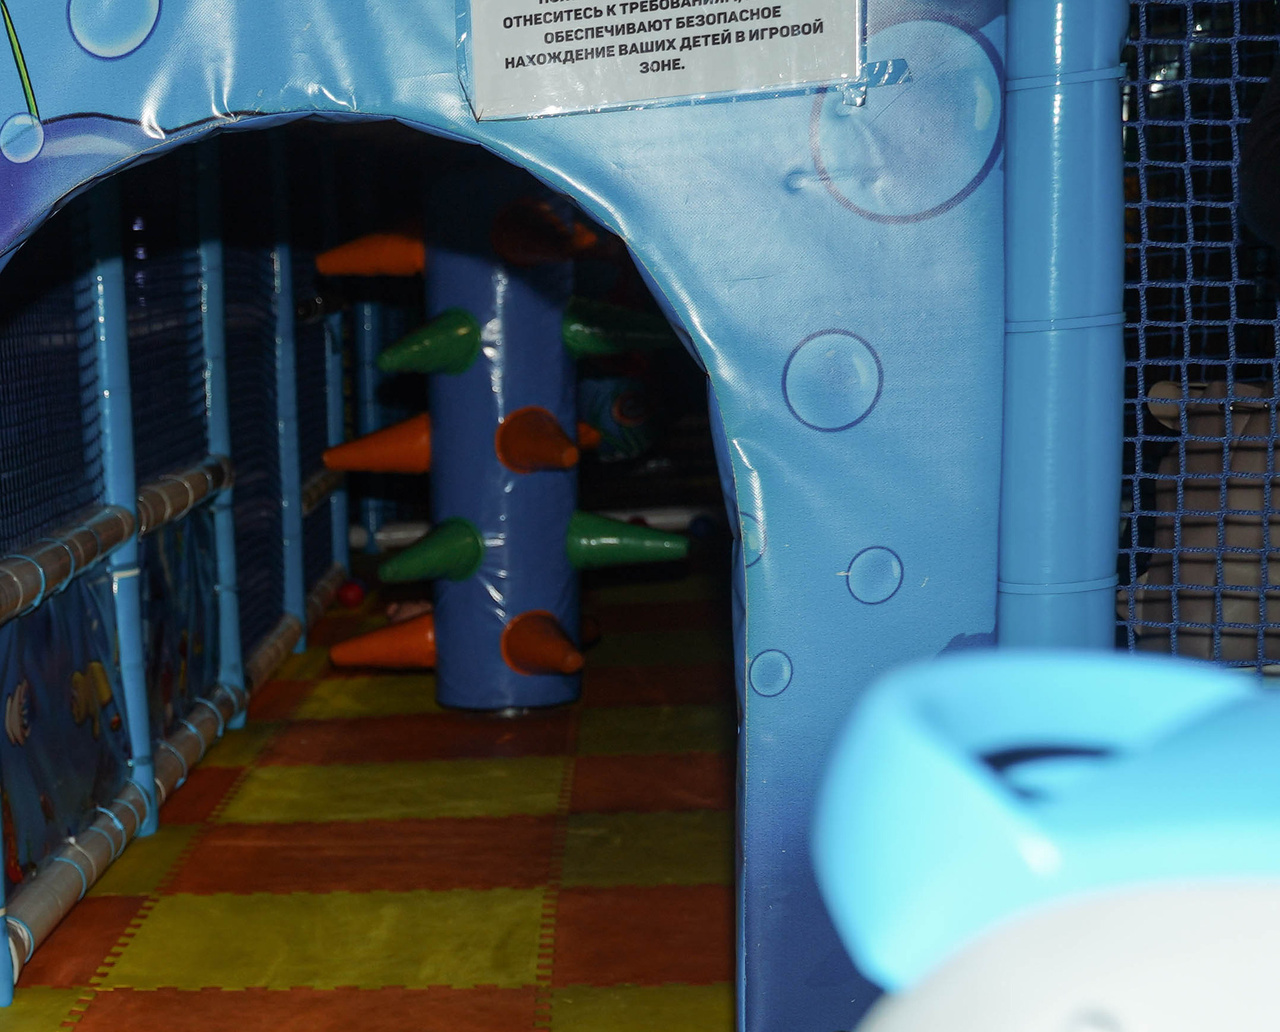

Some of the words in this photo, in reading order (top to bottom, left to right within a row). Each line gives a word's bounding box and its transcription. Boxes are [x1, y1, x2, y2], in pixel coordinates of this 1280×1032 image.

[502, 7, 603, 29] ОТНЕСИТЕСЬ
[606, 4, 617, 16] К
[543, 18, 673, 45] ОБЕСПЕЧИВАЮТ
[676, 6, 781, 28] БЕЗОПАСНОЕ
[505, 45, 615, 69] НАХОЖДЕНИЕ
[619, 38, 676, 55] ВАШИХ
[680, 29, 731, 51] ДЕТЕЙ
[735, 30, 746, 43] В
[749, 19, 823, 41] ИГРОВОЙ
[639, 58, 685, 73] ЗОНЕ.
